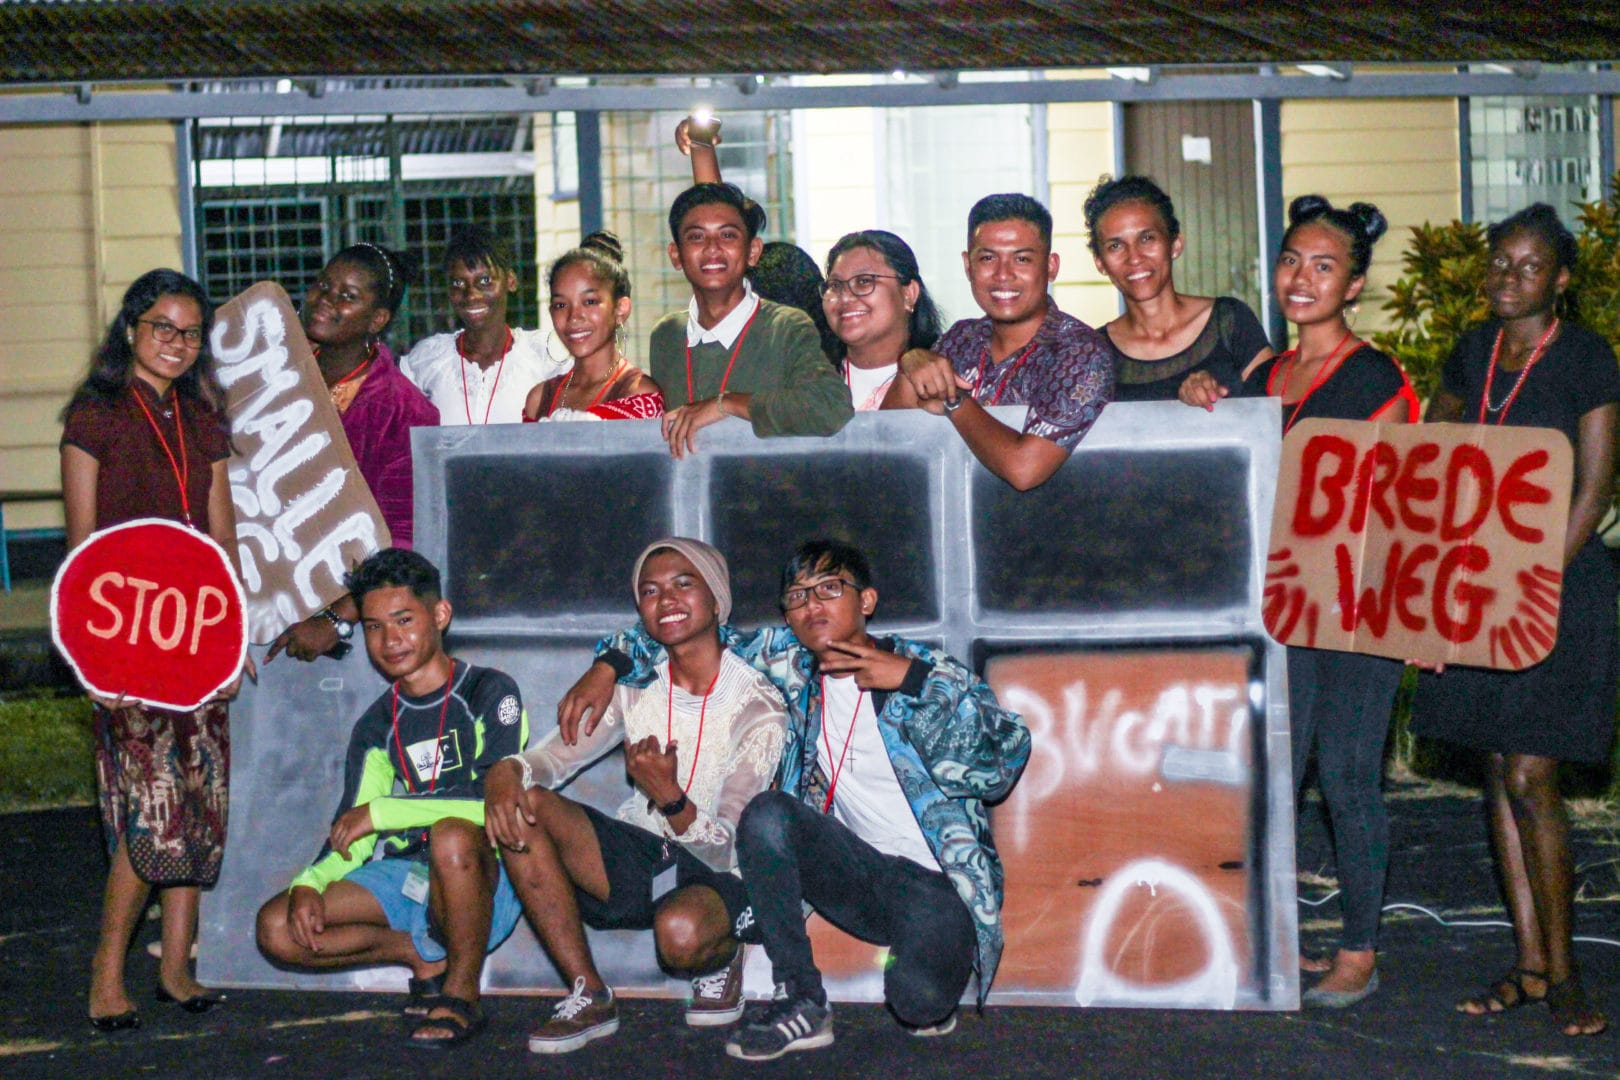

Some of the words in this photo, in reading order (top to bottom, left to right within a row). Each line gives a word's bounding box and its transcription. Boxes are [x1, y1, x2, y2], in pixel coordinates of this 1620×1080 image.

[211, 300, 380, 609] SMALLE
[1292, 435, 1552, 544] BREDE
[86, 571, 228, 655] STOP
[1334, 541, 1497, 644] WEG
